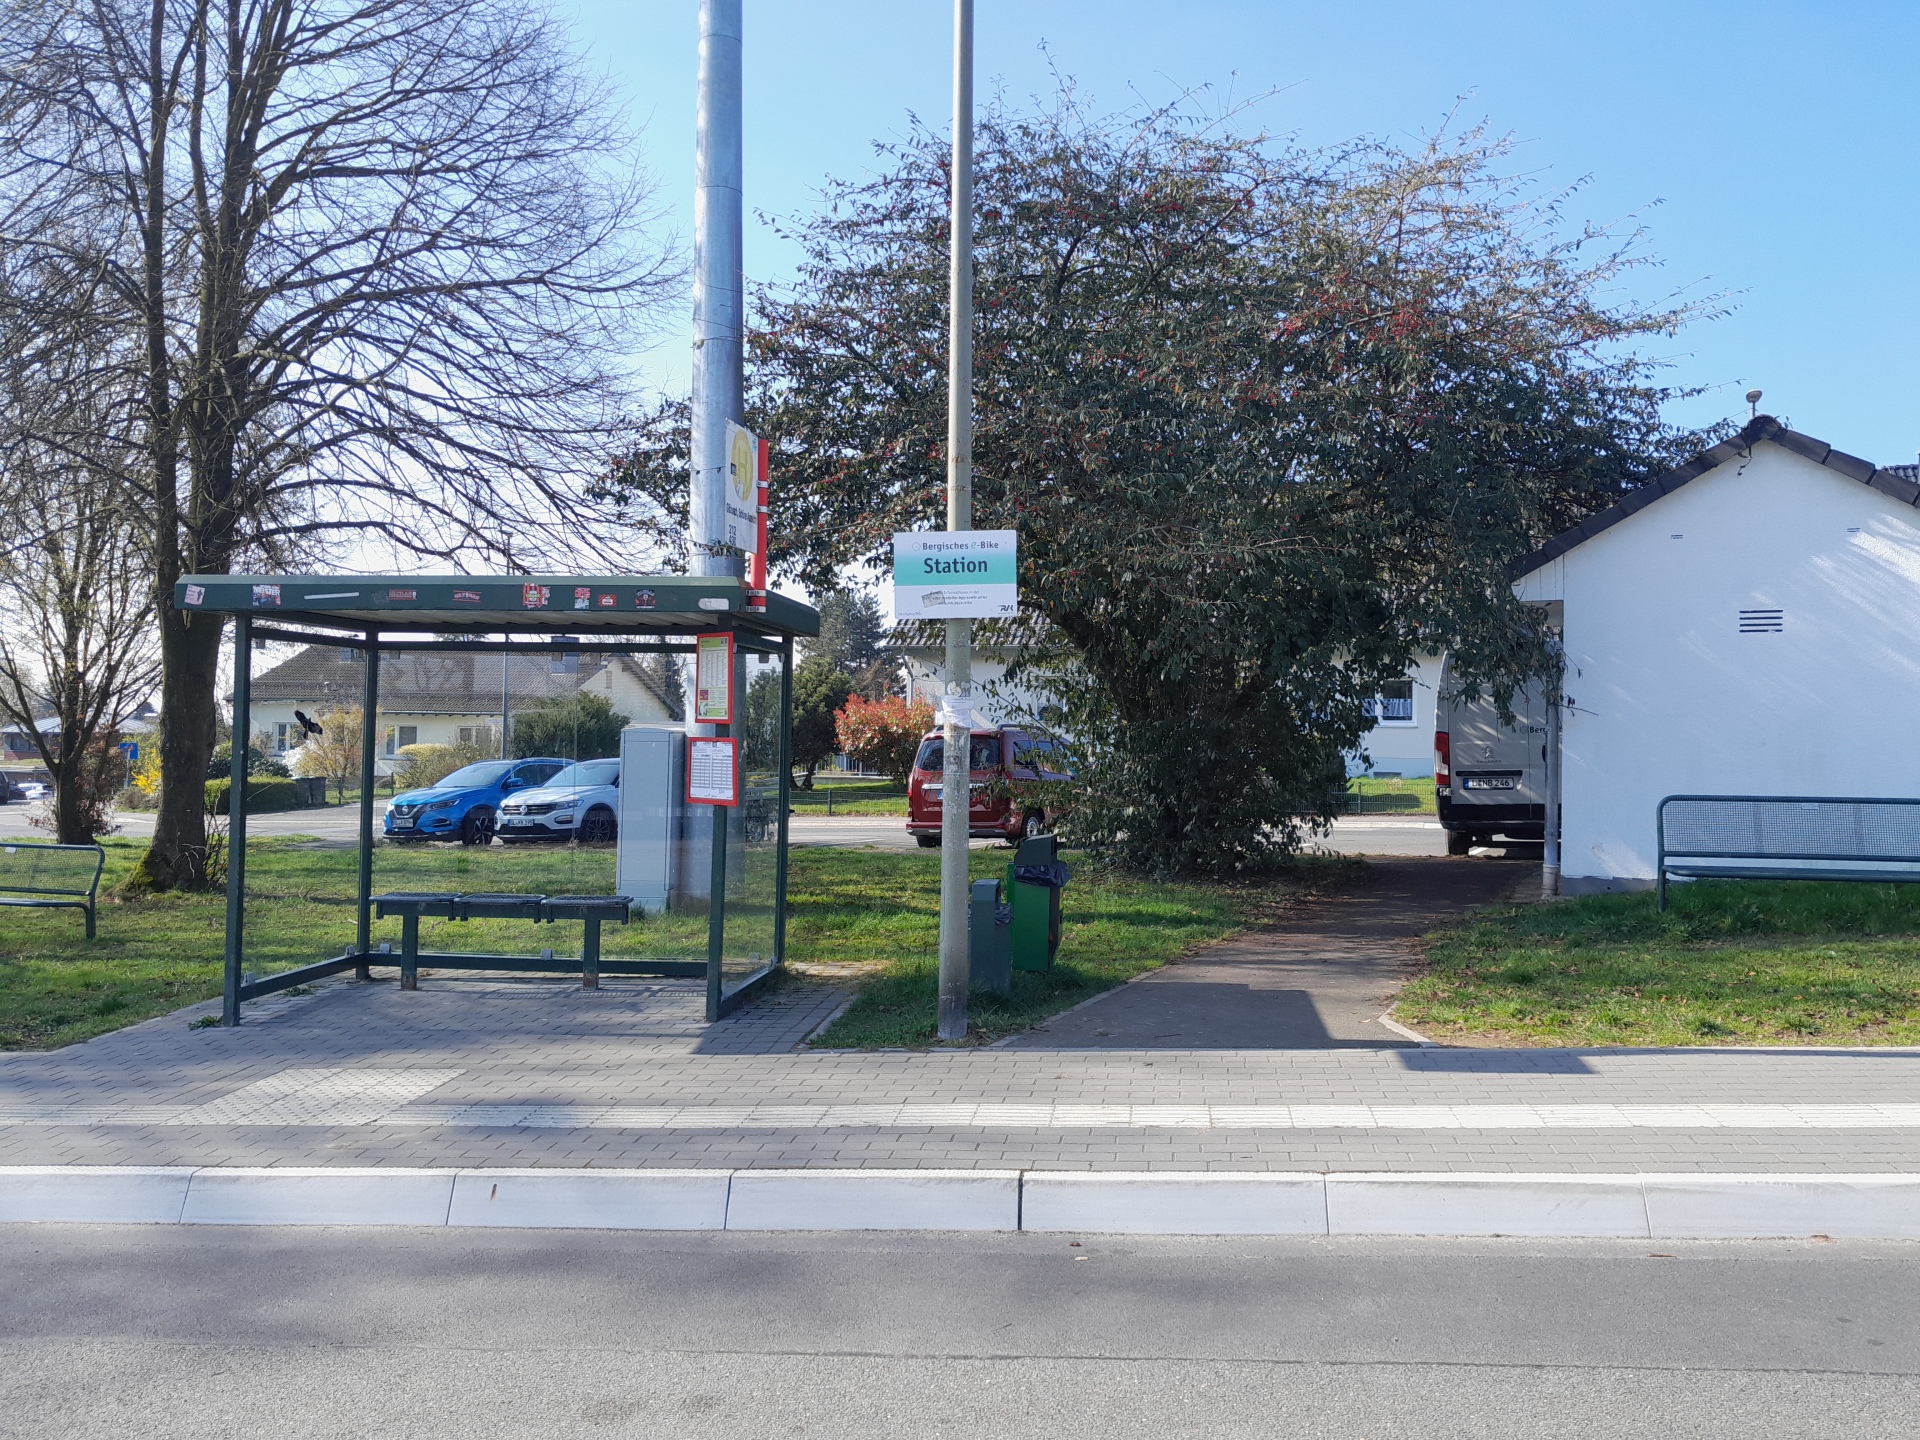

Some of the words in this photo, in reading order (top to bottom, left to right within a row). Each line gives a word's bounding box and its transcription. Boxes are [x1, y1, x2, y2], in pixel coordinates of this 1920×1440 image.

[729, 524, 737, 536] 212
[729, 535, 737, 547] 430
[922, 542, 969, 552] Bergisches
[971, 541, 999, 550] e-Bike
[924, 556, 988, 574] Station
[1494, 779, 1510, 787] 246
